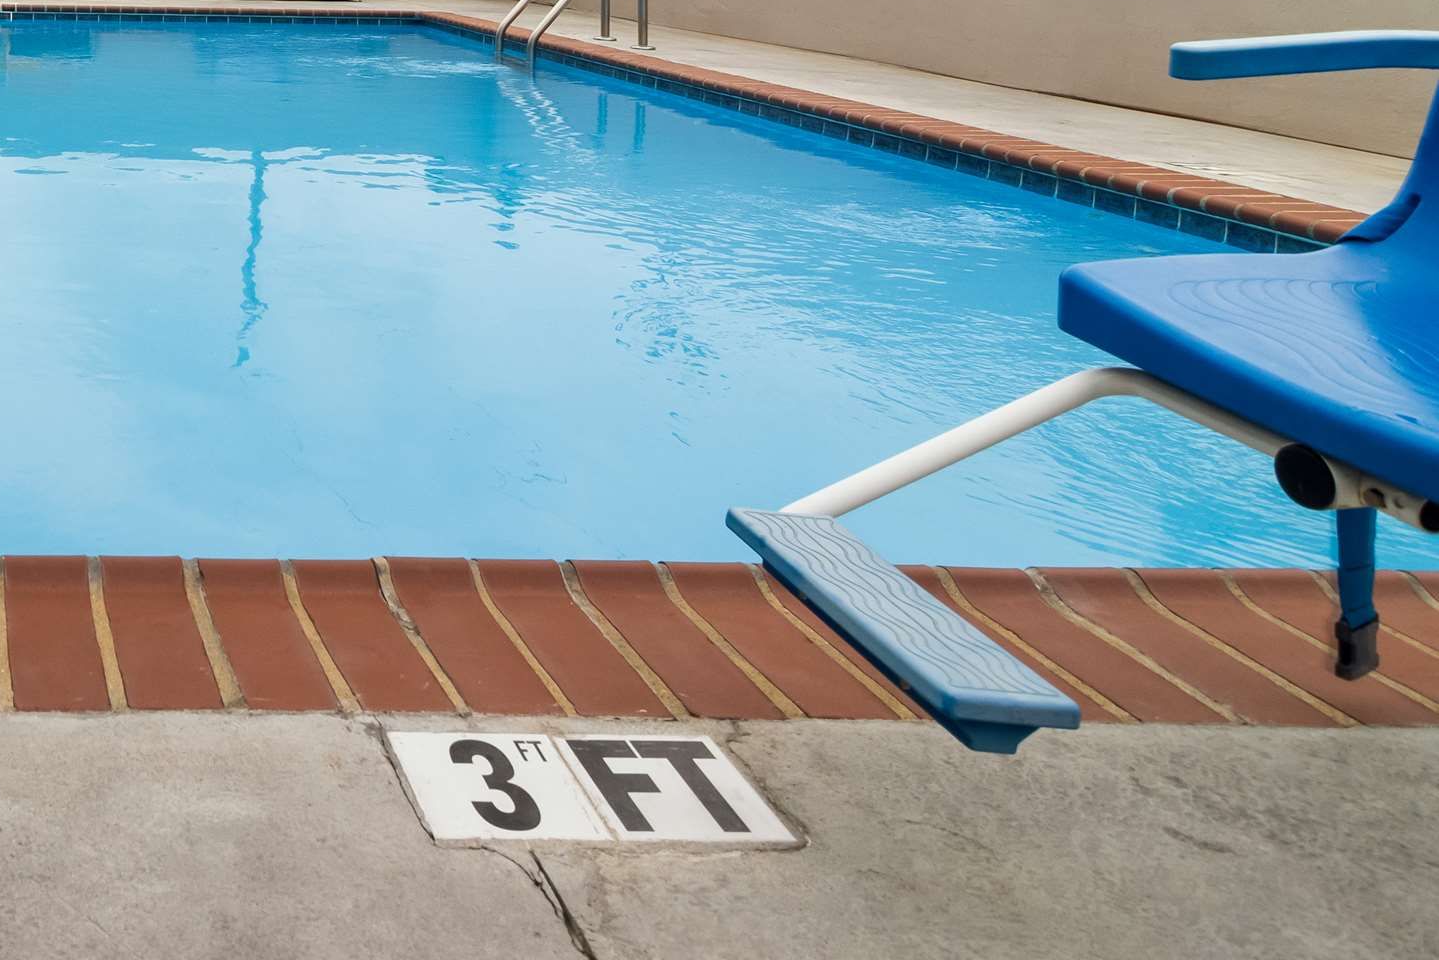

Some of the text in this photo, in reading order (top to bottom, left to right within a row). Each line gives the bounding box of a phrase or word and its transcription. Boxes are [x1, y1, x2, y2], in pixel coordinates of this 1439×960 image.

[449, 739, 752, 833] 3 FT FT
